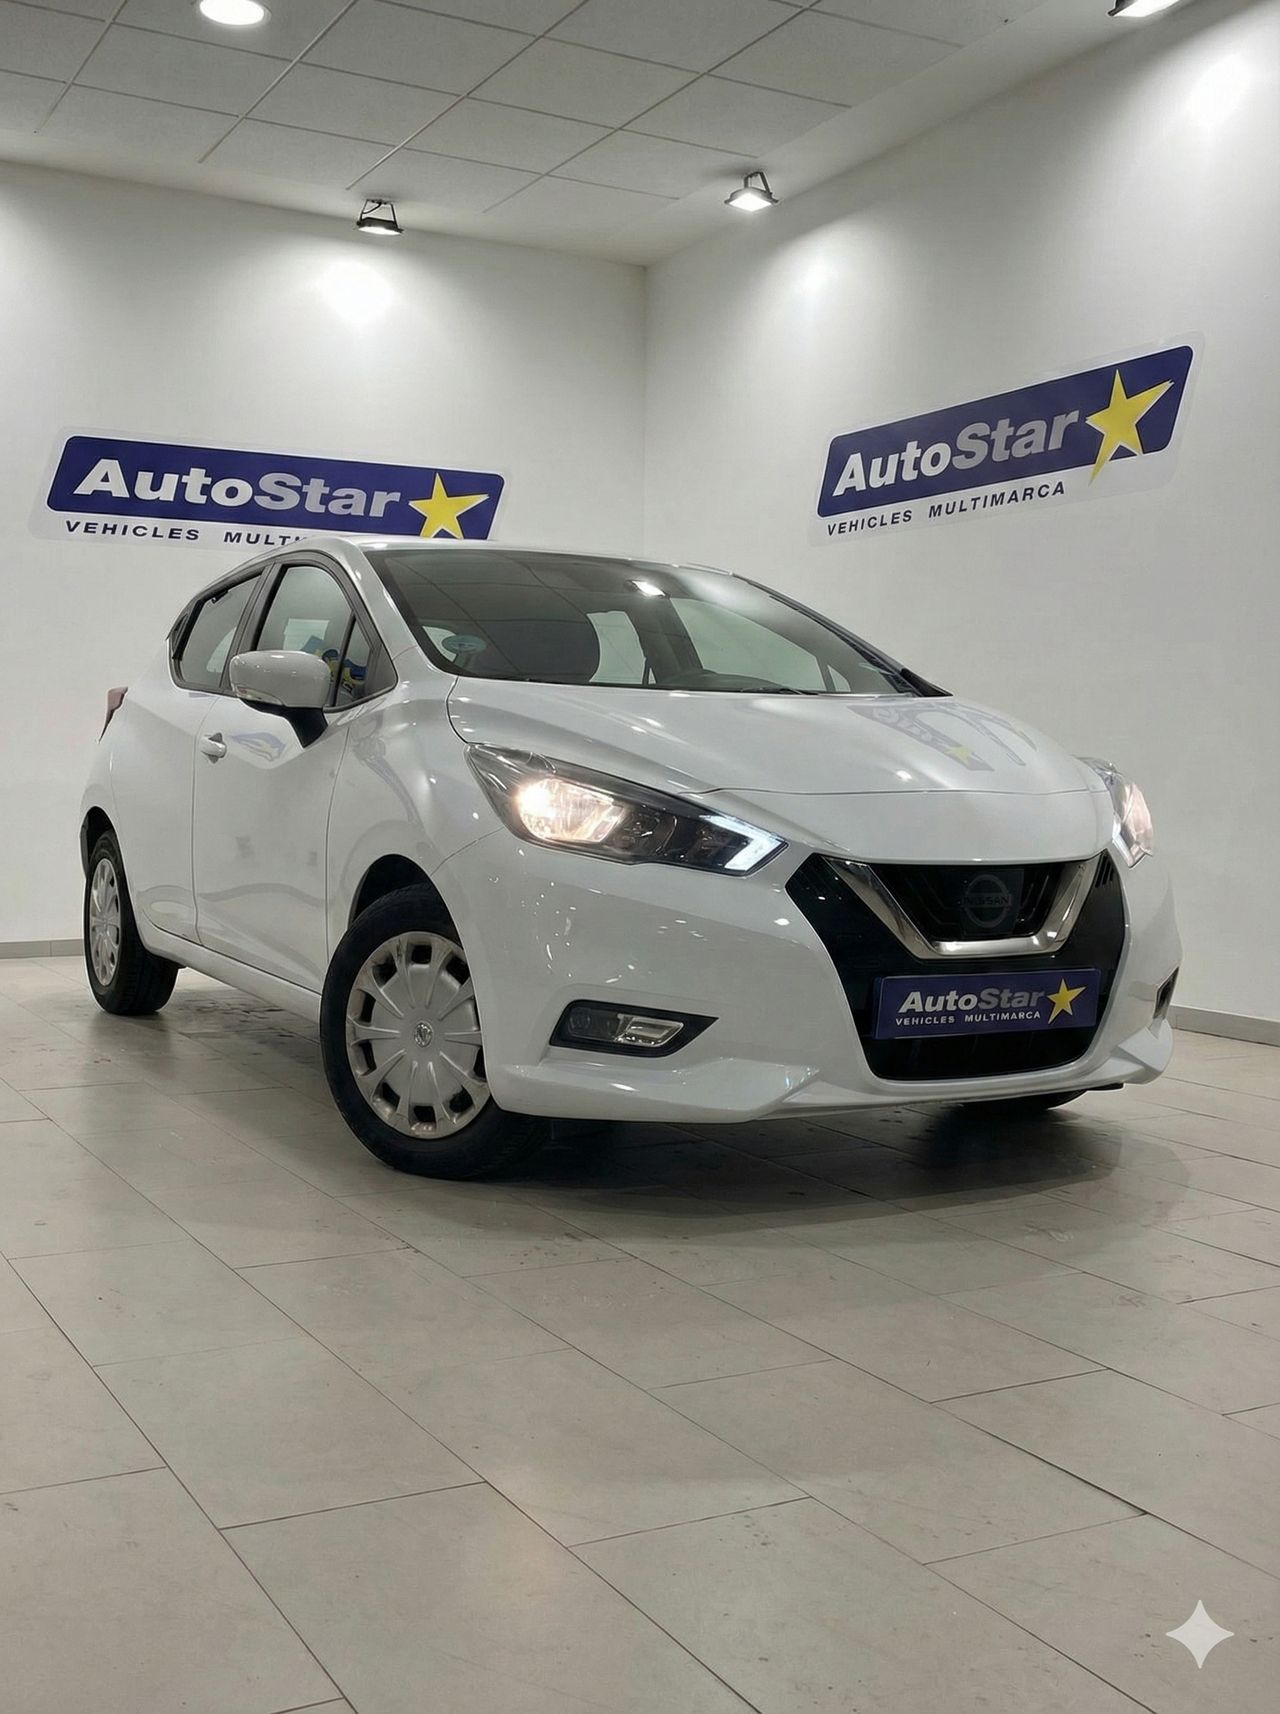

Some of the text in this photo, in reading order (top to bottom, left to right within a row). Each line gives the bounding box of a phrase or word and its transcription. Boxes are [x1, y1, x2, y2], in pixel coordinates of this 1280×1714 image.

[832, 410, 1080, 497] AutoStar
[73, 458, 401, 517] AutoStar
[827, 481, 1065, 536] VEHICLES MULTIMARCA
[65, 520, 200, 541] VEHICLES
[895, 1011, 1041, 1026] VEHICLES MULTIMARCA
[898, 988, 1046, 1013] AutoStar
